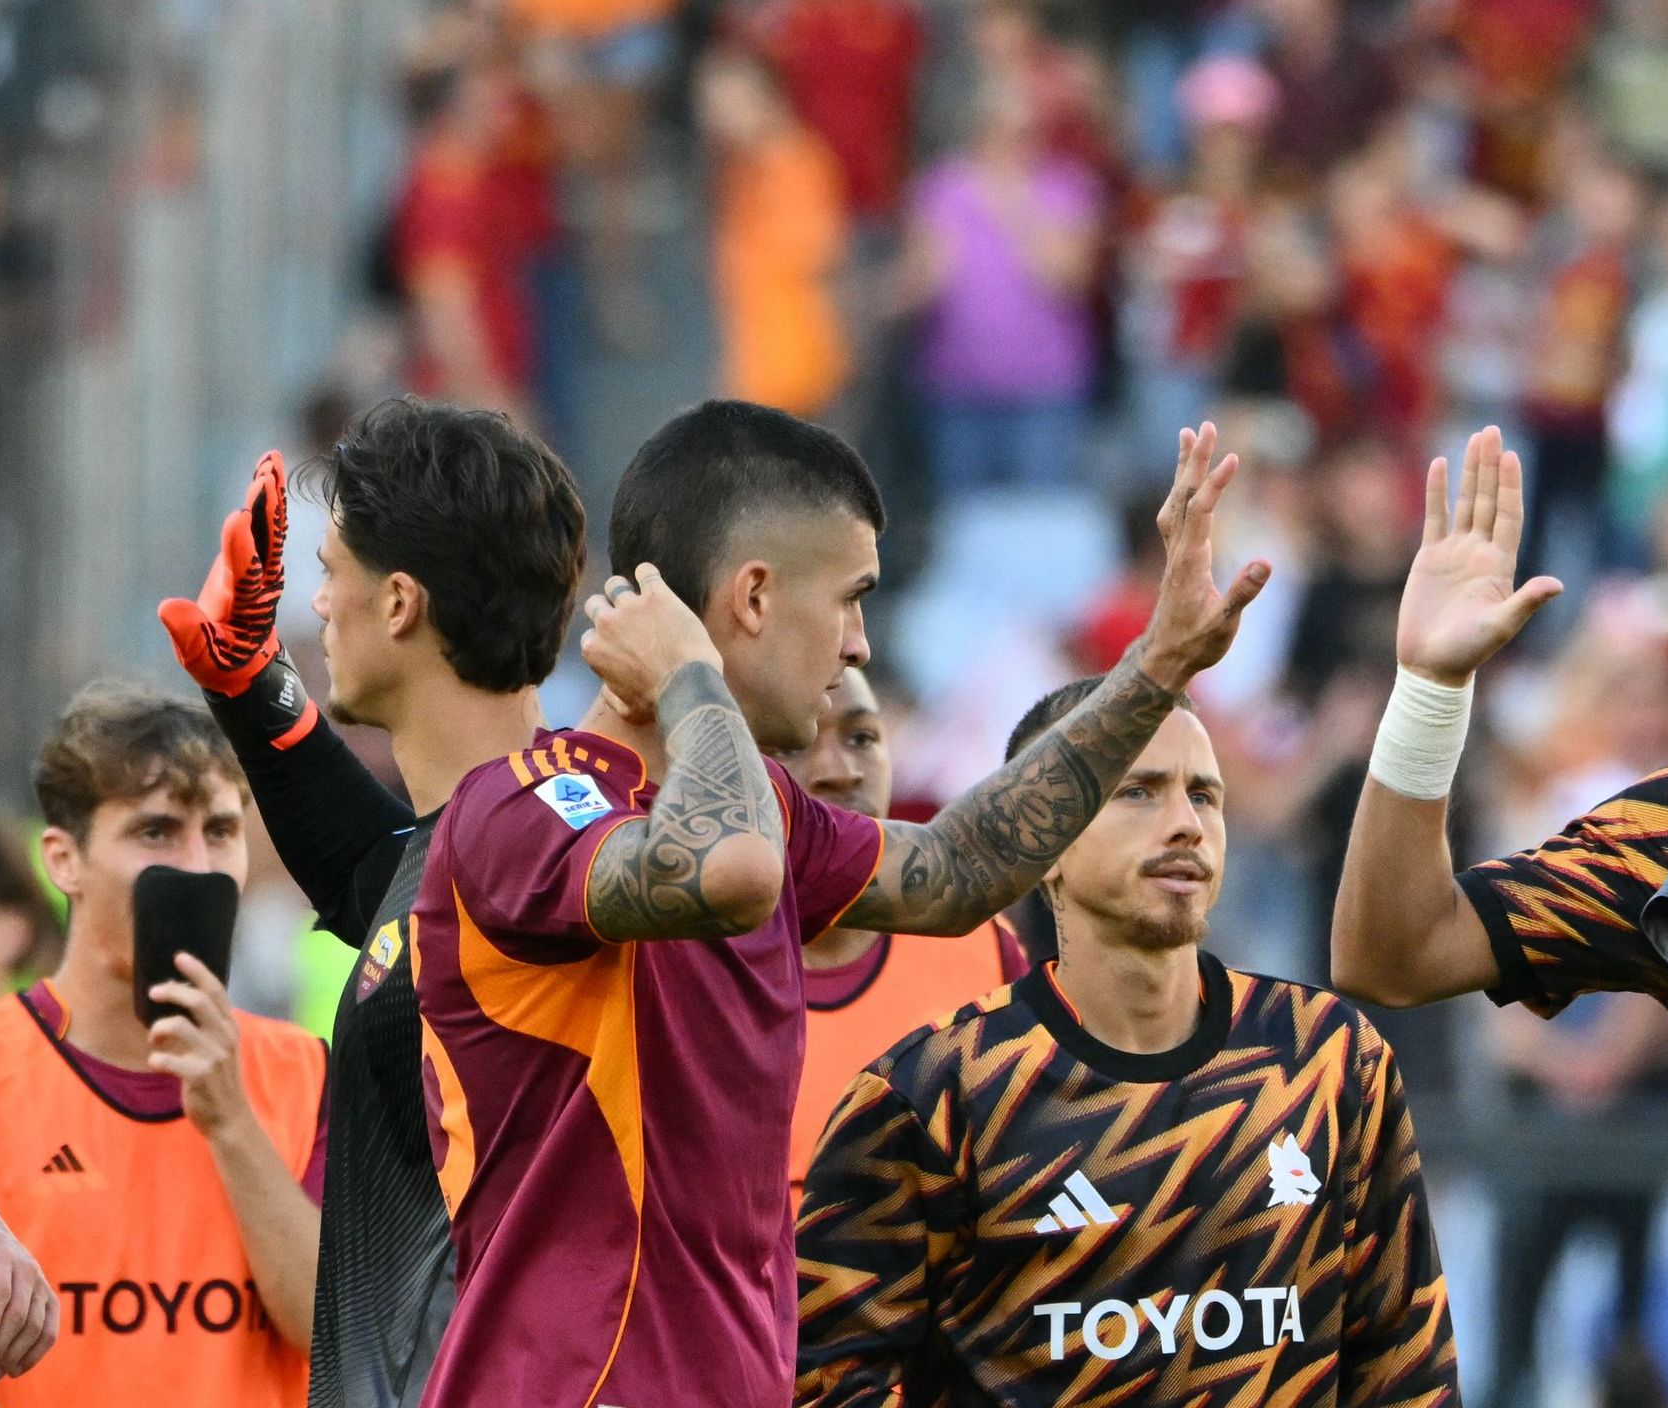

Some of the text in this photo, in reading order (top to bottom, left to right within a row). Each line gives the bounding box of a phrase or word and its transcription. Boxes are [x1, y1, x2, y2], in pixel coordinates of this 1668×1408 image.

[564, 801, 593, 813] SERIE
[59, 1279, 270, 1334] TOYO
[1034, 1285, 1305, 1361] TOYOTA
